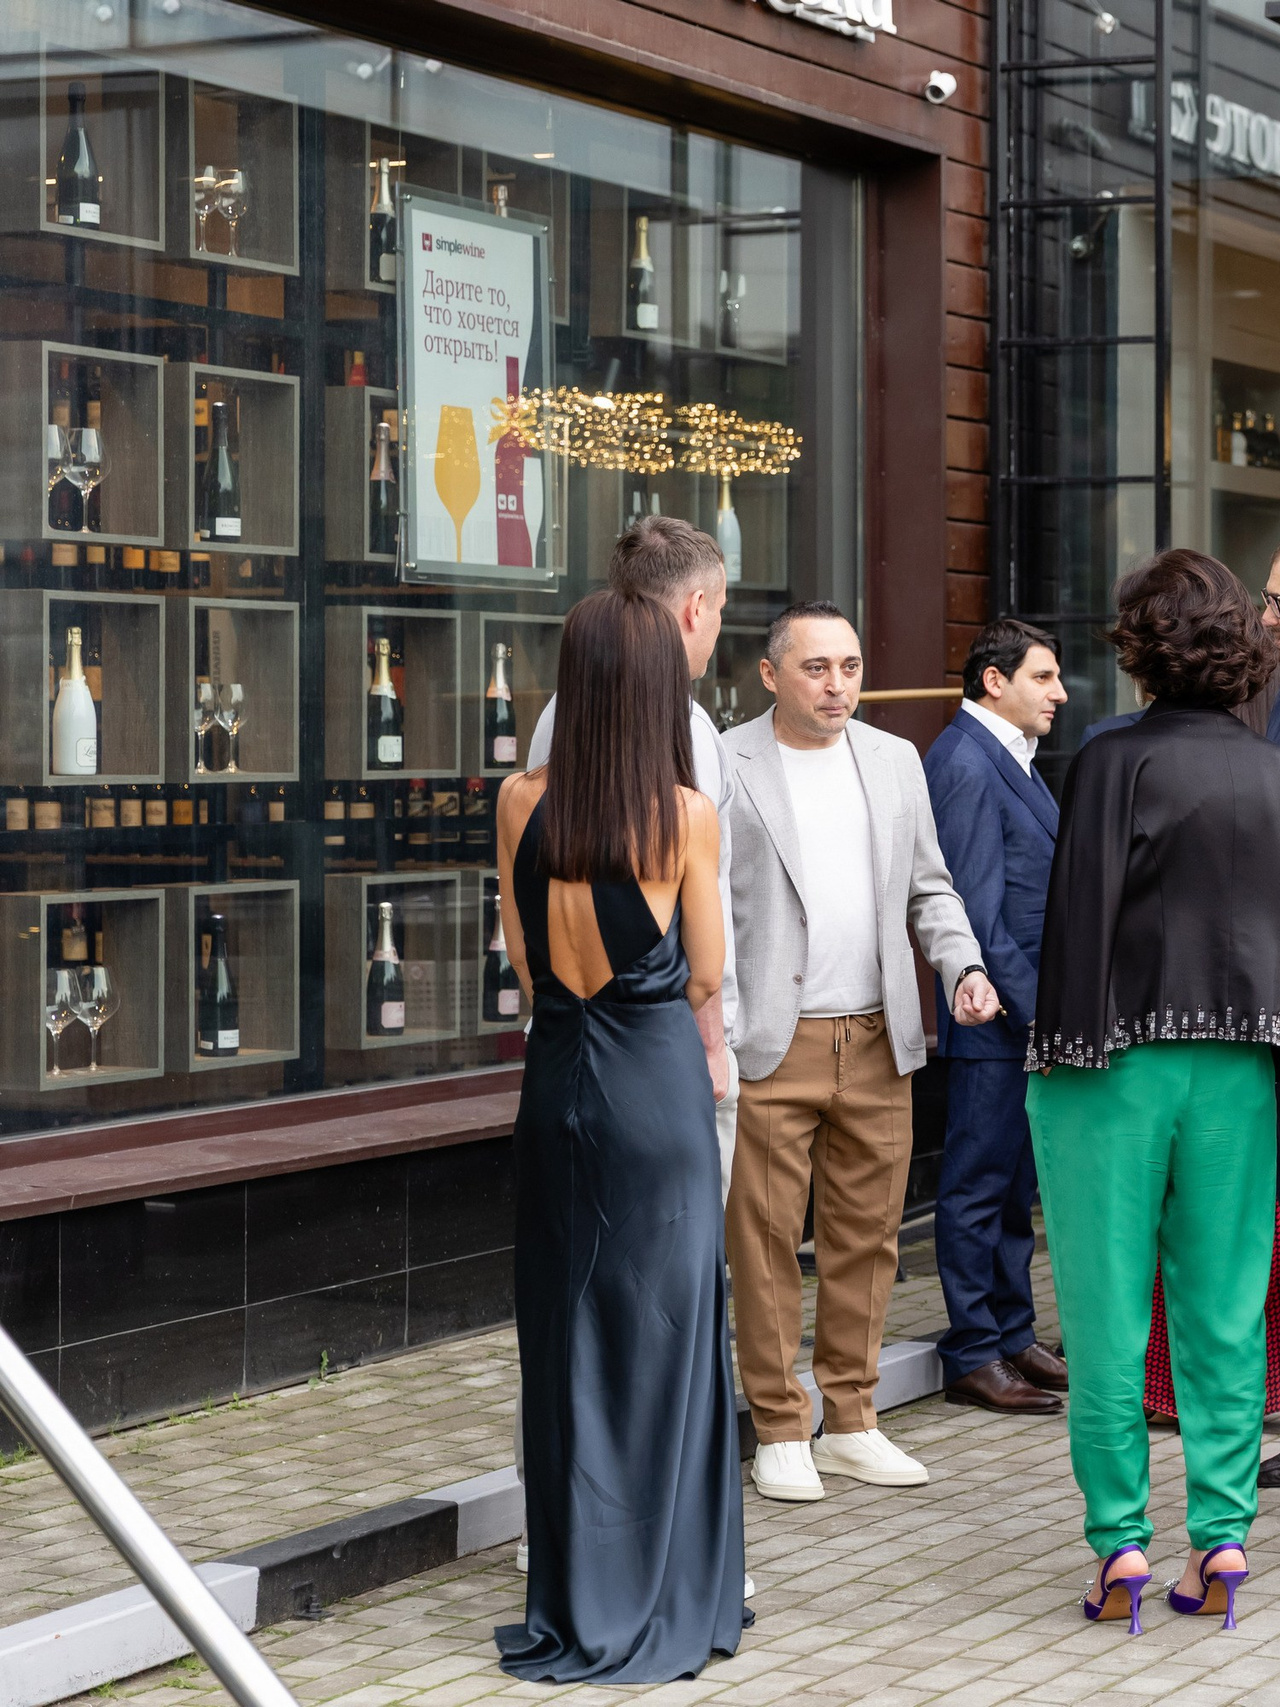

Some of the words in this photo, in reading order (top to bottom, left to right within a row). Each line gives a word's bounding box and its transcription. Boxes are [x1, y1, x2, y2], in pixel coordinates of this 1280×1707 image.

[435, 236, 486, 259] simplewine
[422, 269, 483, 304] Дарите
[488, 287, 511, 313] то,
[423, 304, 452, 326] что
[457, 310, 519, 338] хочется
[424, 334, 498, 364] открыть!
